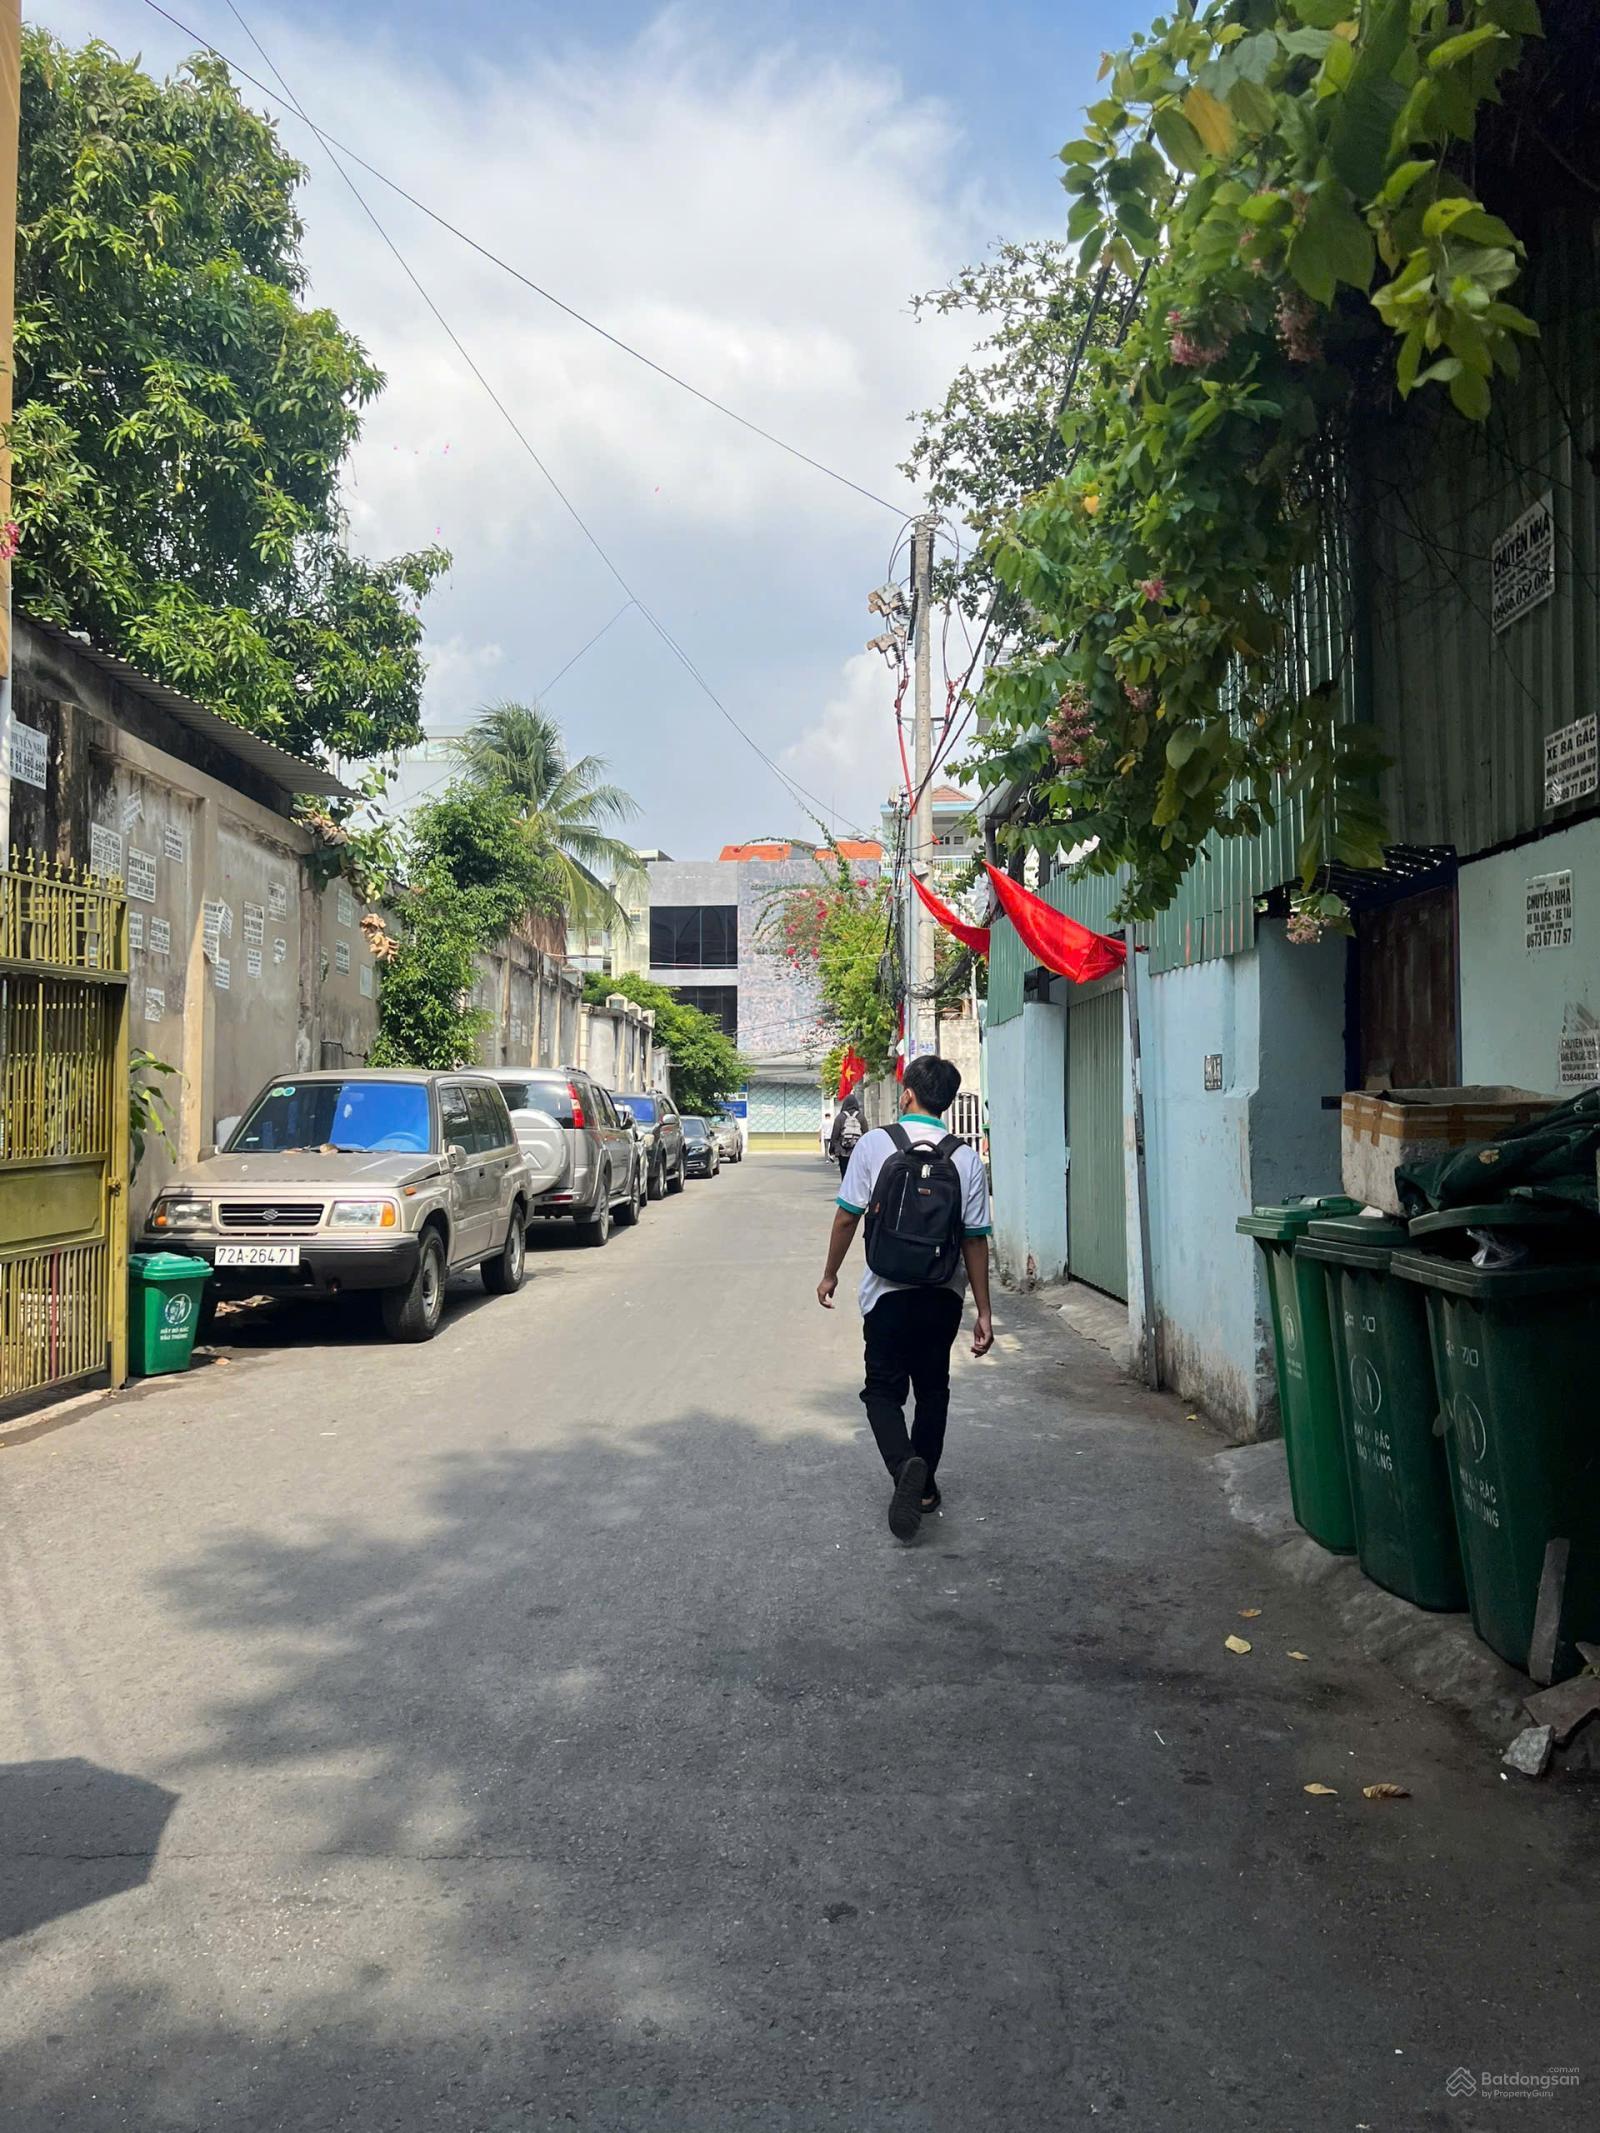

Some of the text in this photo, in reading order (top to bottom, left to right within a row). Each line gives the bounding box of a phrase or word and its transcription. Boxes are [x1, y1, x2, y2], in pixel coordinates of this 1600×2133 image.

[1560, 738, 1573, 755] BA
[1526, 885, 1571, 910] CHUYỂN NHÀ
[1554, 929, 1562, 944] 17
